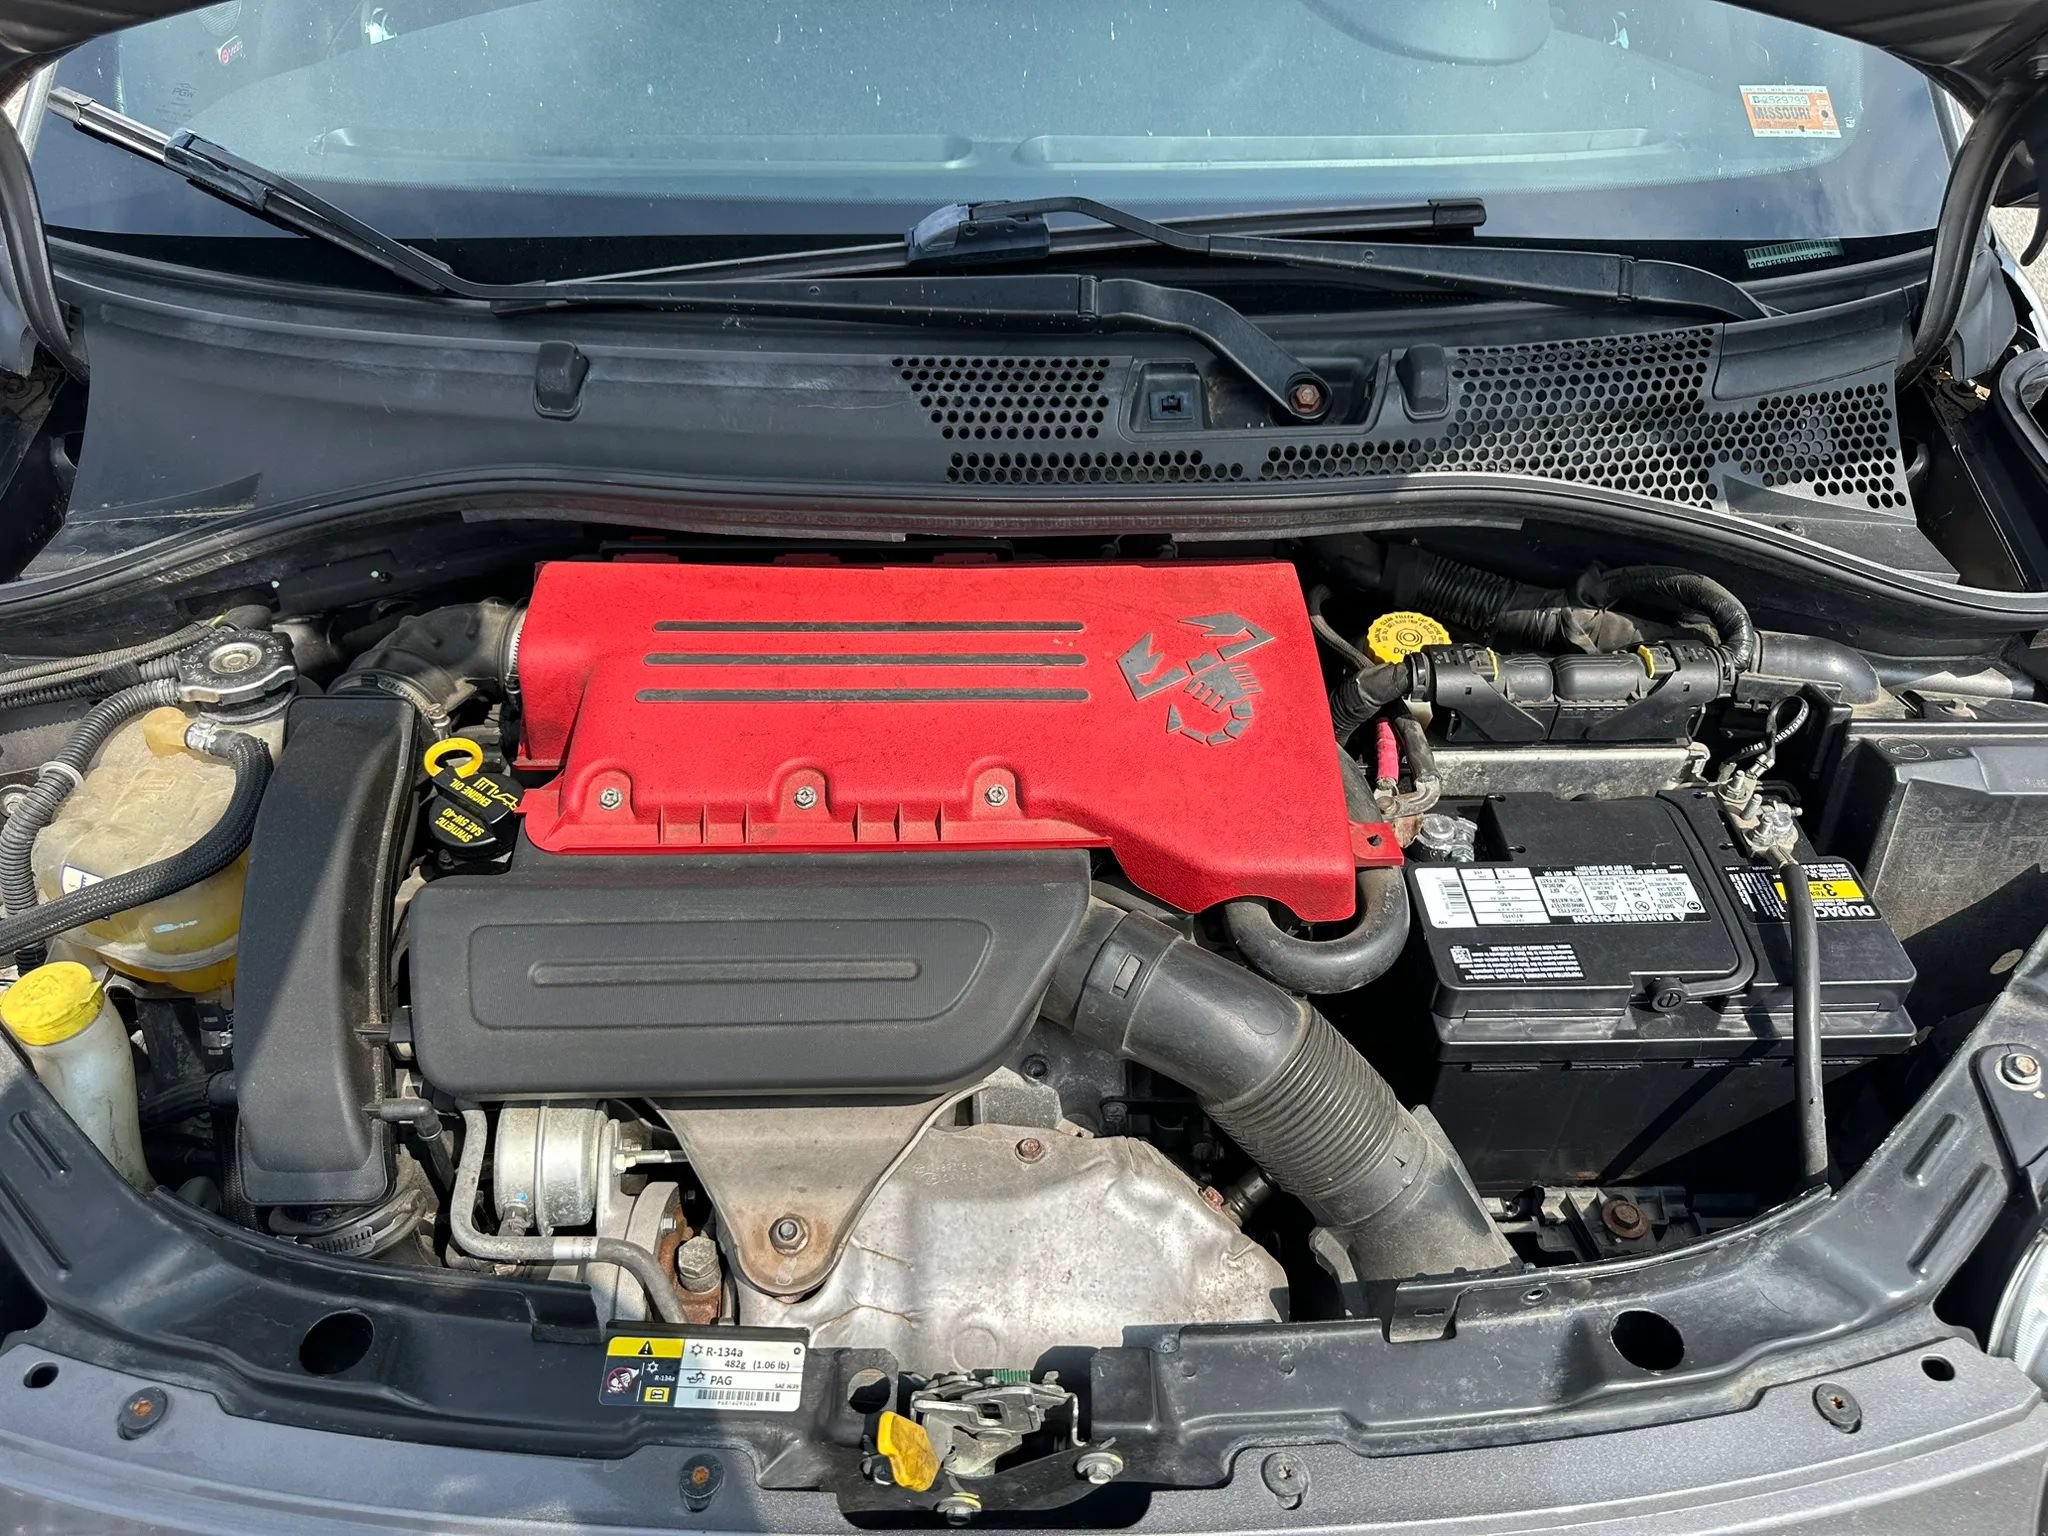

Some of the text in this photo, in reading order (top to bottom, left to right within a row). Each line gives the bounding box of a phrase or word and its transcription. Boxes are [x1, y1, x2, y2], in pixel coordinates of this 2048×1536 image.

[1753, 106, 1811, 120] MISSOURI
[449, 778, 492, 807] ENGINE OIL
[442, 808, 485, 837] SAE 5W-40
[434, 817, 473, 843] SYNTHETIC
[1822, 883, 1838, 897] 3
[1572, 913, 1674, 923] DANGER/POISON
[1813, 904, 1876, 918] DURAC
[707, 1346, 743, 1357] R-134a
[725, 1360, 790, 1371] 482g (1.06 lb)
[711, 1375, 733, 1386] PAG
